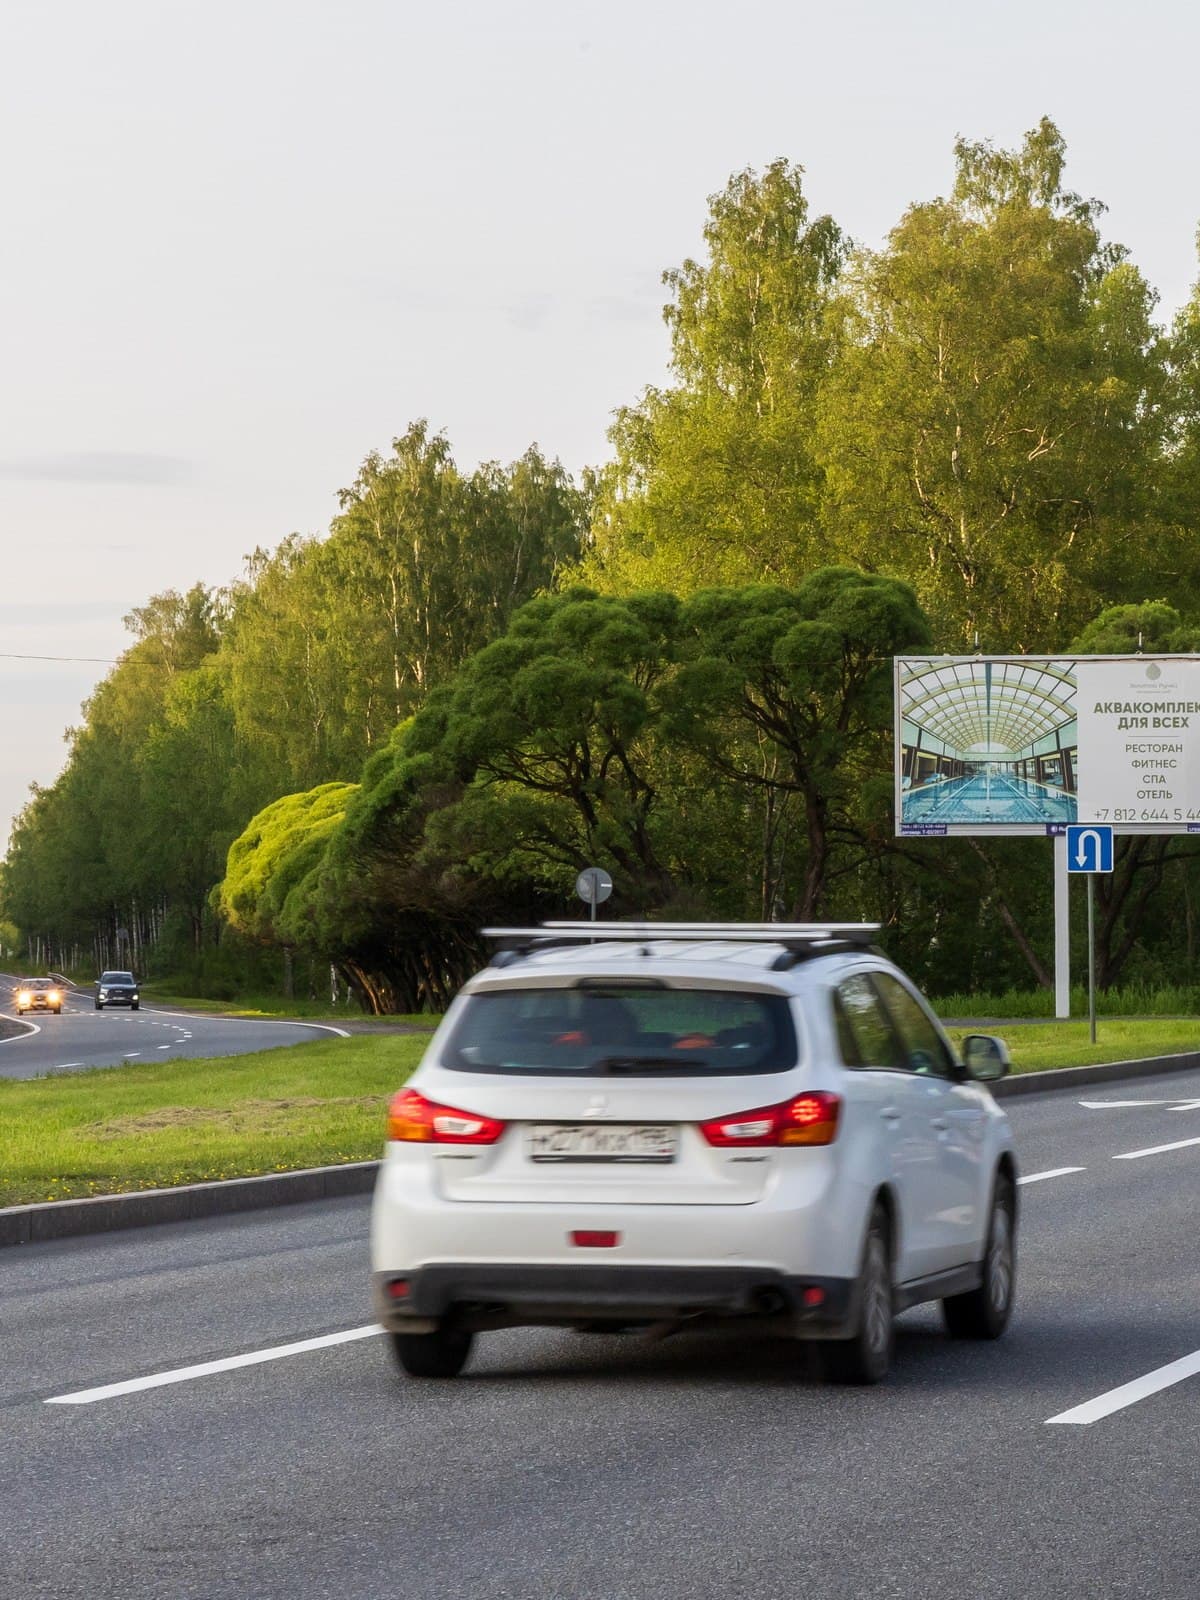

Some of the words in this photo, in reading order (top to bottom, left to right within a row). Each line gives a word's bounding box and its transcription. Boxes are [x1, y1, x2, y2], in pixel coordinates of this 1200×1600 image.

[1118, 717, 1148, 730] ДЛЯ
[1152, 717, 1190, 729] ВСЕХ
[1125, 744, 1183, 753] РЕСТОРАН
[1131, 759, 1177, 769] ФИТНЕС
[1142, 775, 1167, 784] СПА
[1136, 790, 1173, 800] ОТЕЛЬ
[1094, 809, 1109, 821] +7
[1114, 808, 1136, 821] 812
[1140, 808, 1169, 821] 644
[1174, 808, 1182, 821] 5
